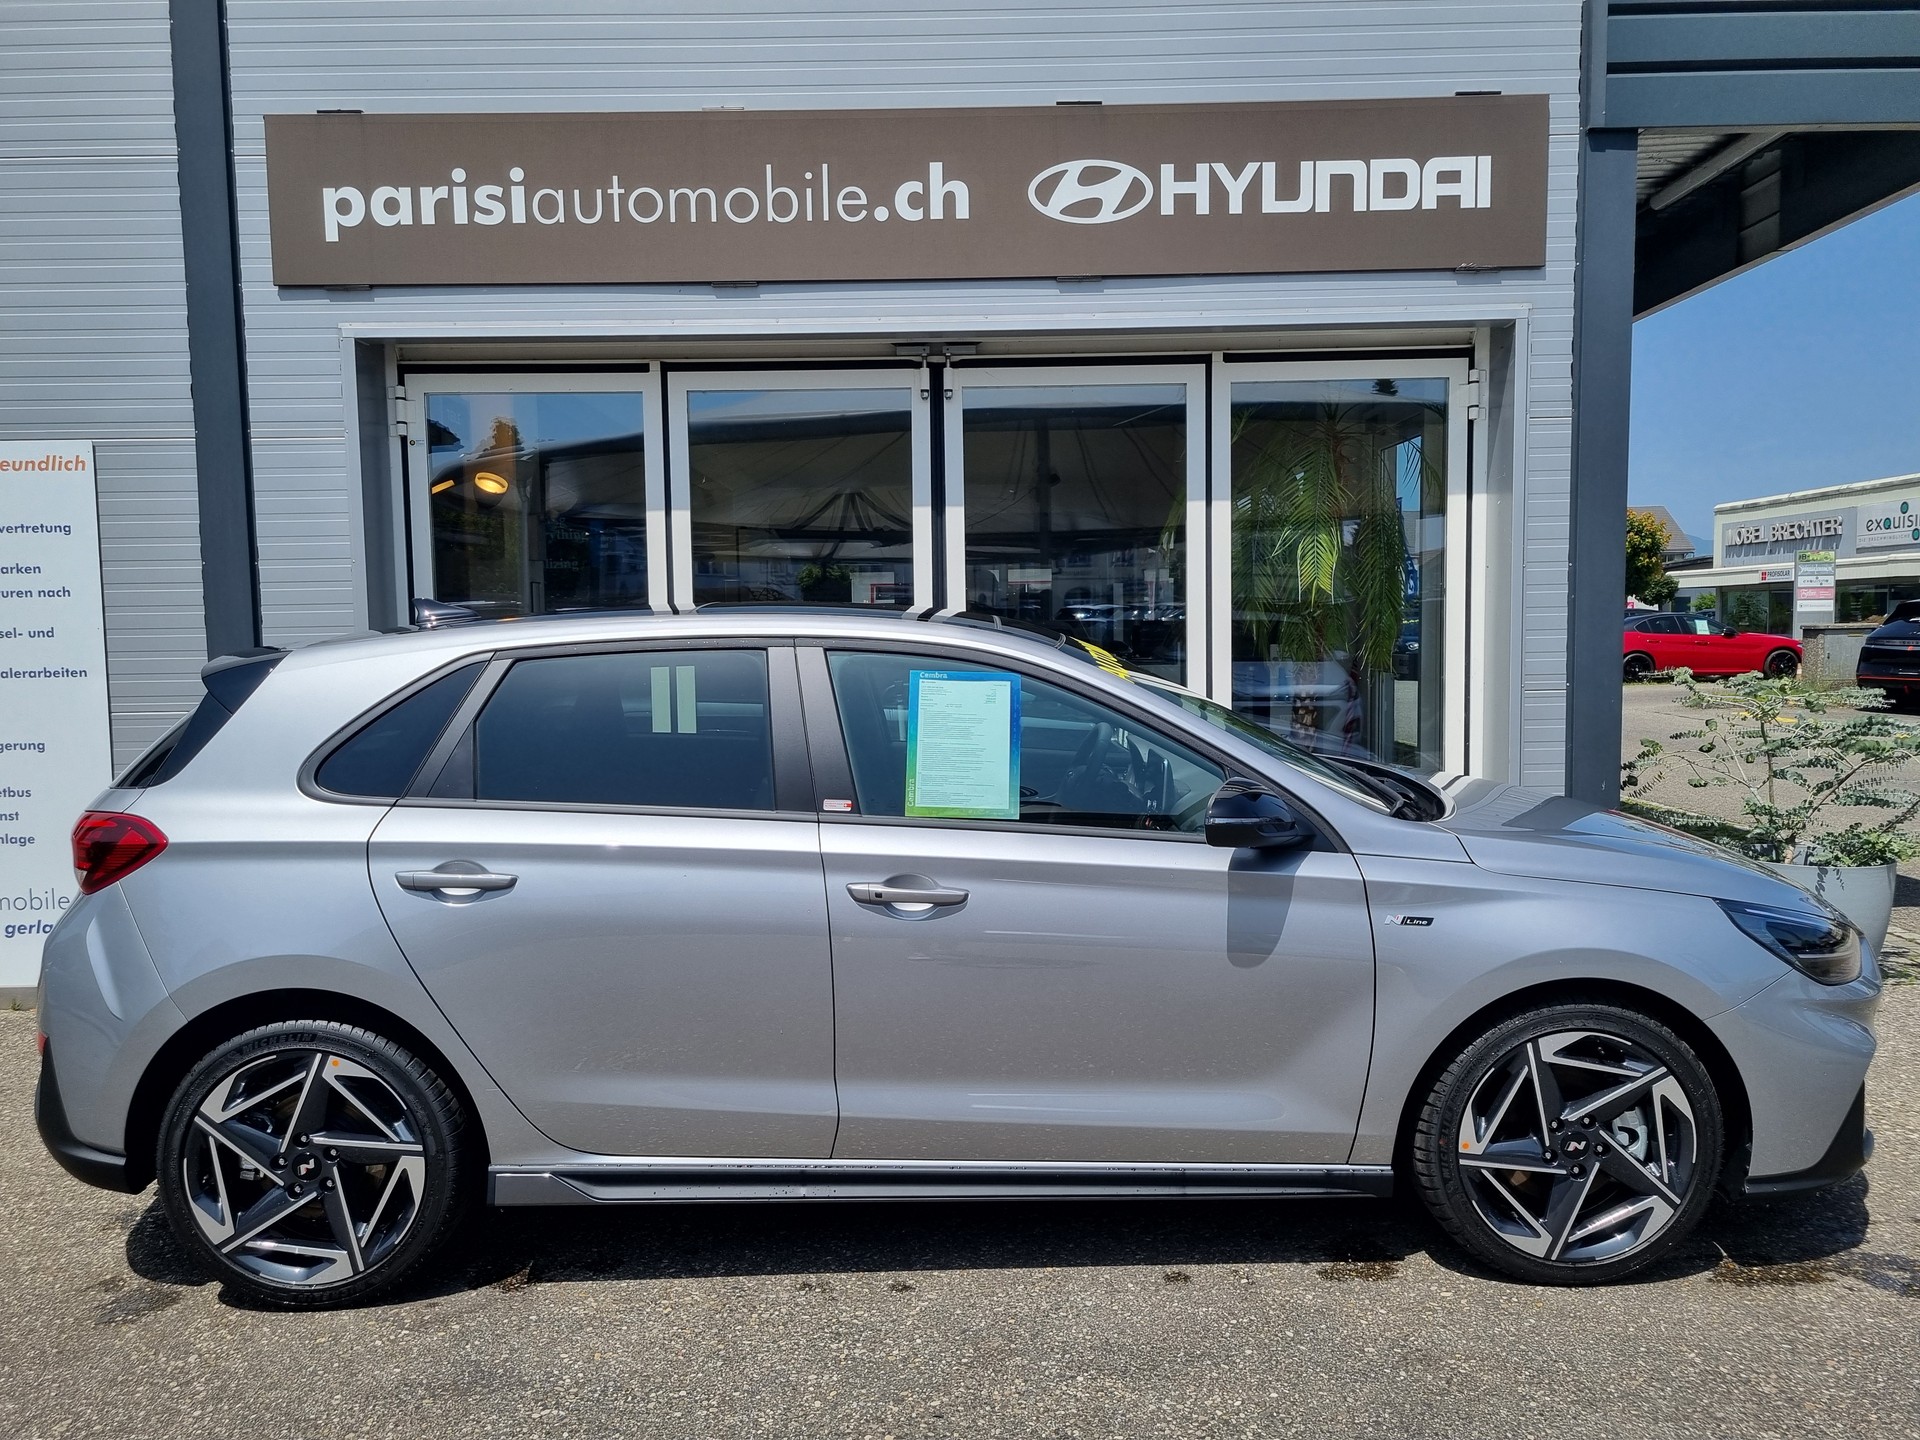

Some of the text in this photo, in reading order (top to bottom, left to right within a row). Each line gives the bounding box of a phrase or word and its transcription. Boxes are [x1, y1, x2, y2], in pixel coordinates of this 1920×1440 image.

[1160, 155, 1492, 216] HYUNDAI
[323, 162, 969, 242] parisiautomobile.ch
[0, 455, 87, 472] eundlich
[0, 523, 72, 536] vertretung
[1726, 516, 1842, 545] MÖBEL BRECHTER
[0, 562, 42, 575] arken
[0, 586, 71, 599] uren nach
[0, 626, 55, 639] sel- und
[0, 666, 88, 679] alerarbeiten
[919, 671, 948, 679] Cembra
[907, 778, 915, 807] Cembra
